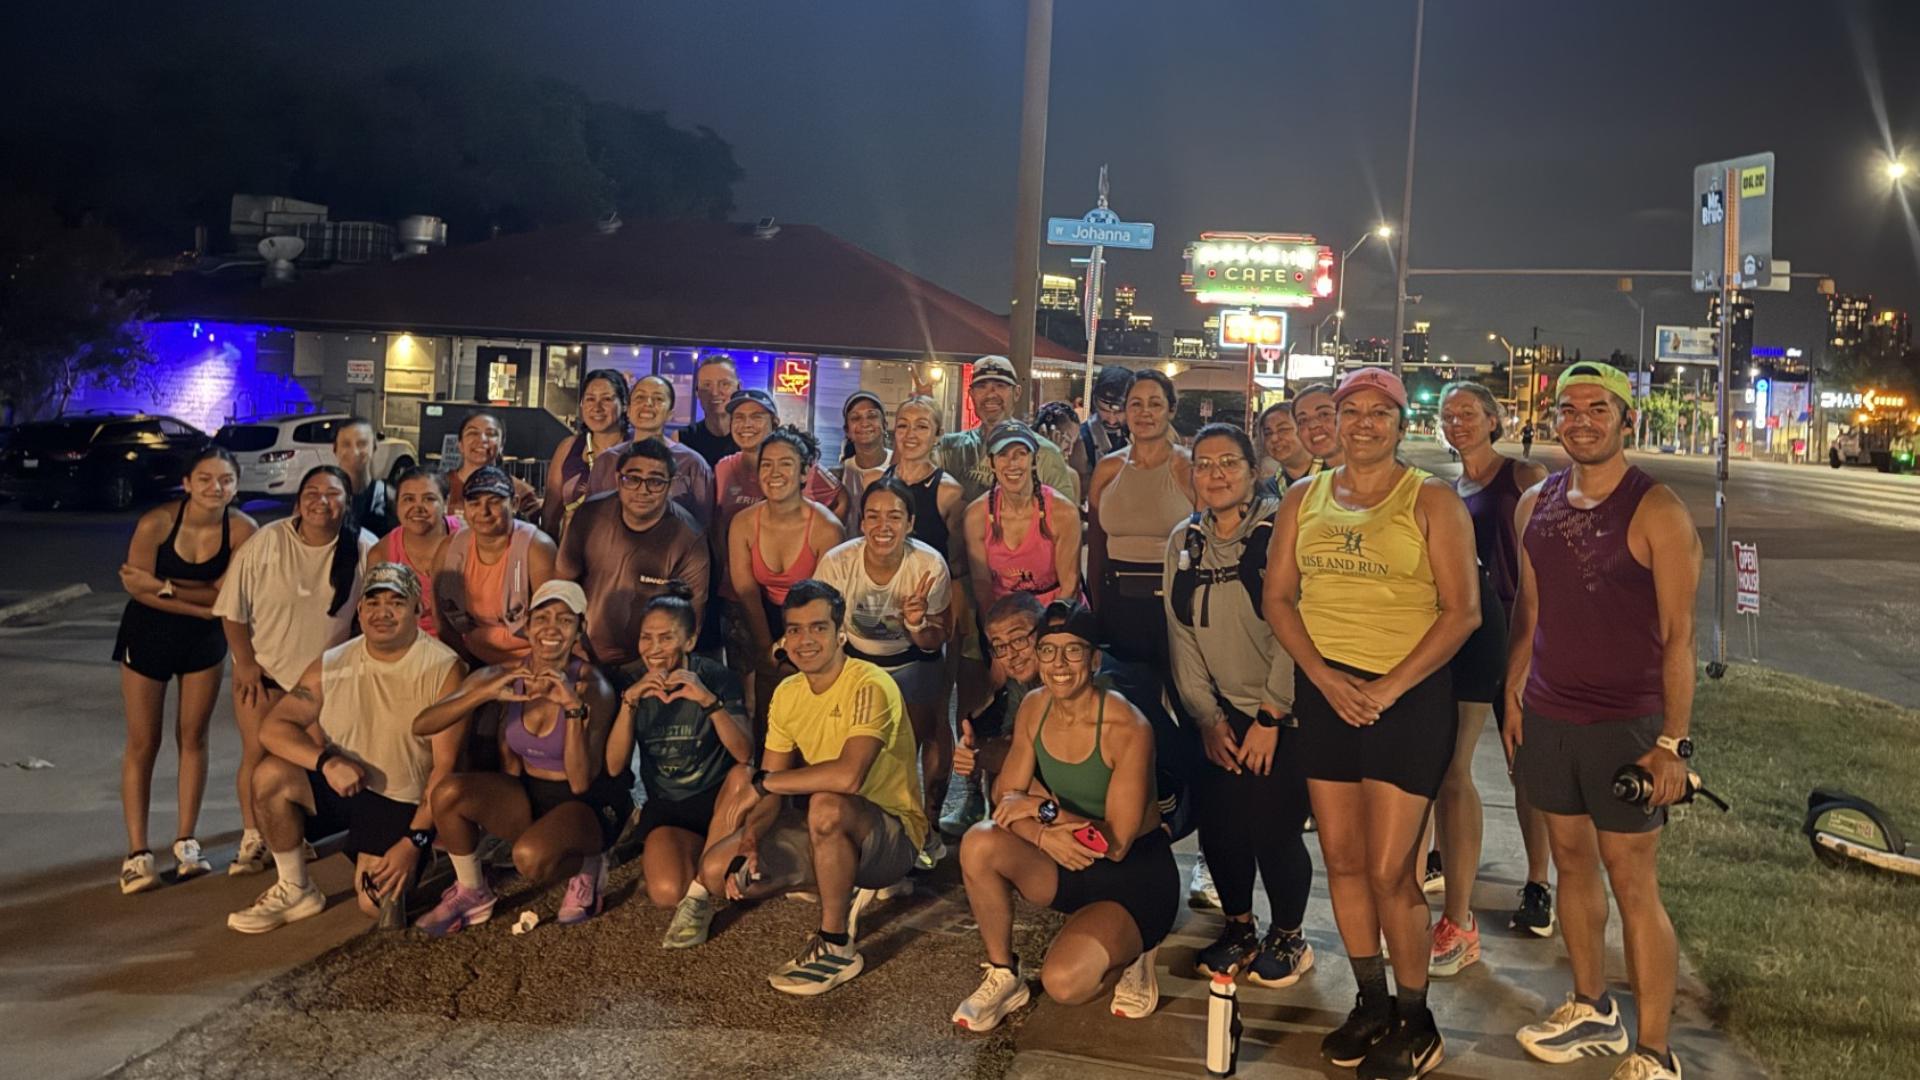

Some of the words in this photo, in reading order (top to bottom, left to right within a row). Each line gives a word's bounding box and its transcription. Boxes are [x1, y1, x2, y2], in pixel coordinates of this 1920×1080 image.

[1055, 226, 1064, 236] W
[1071, 225, 1131, 242] Johanna
[1224, 267, 1288, 283] CAFE
[1325, 557, 1355, 570] AND
[1358, 560, 1389, 576] RUN
[1738, 551, 1758, 570] OPEN
[1738, 571, 1759, 591] HOUS
